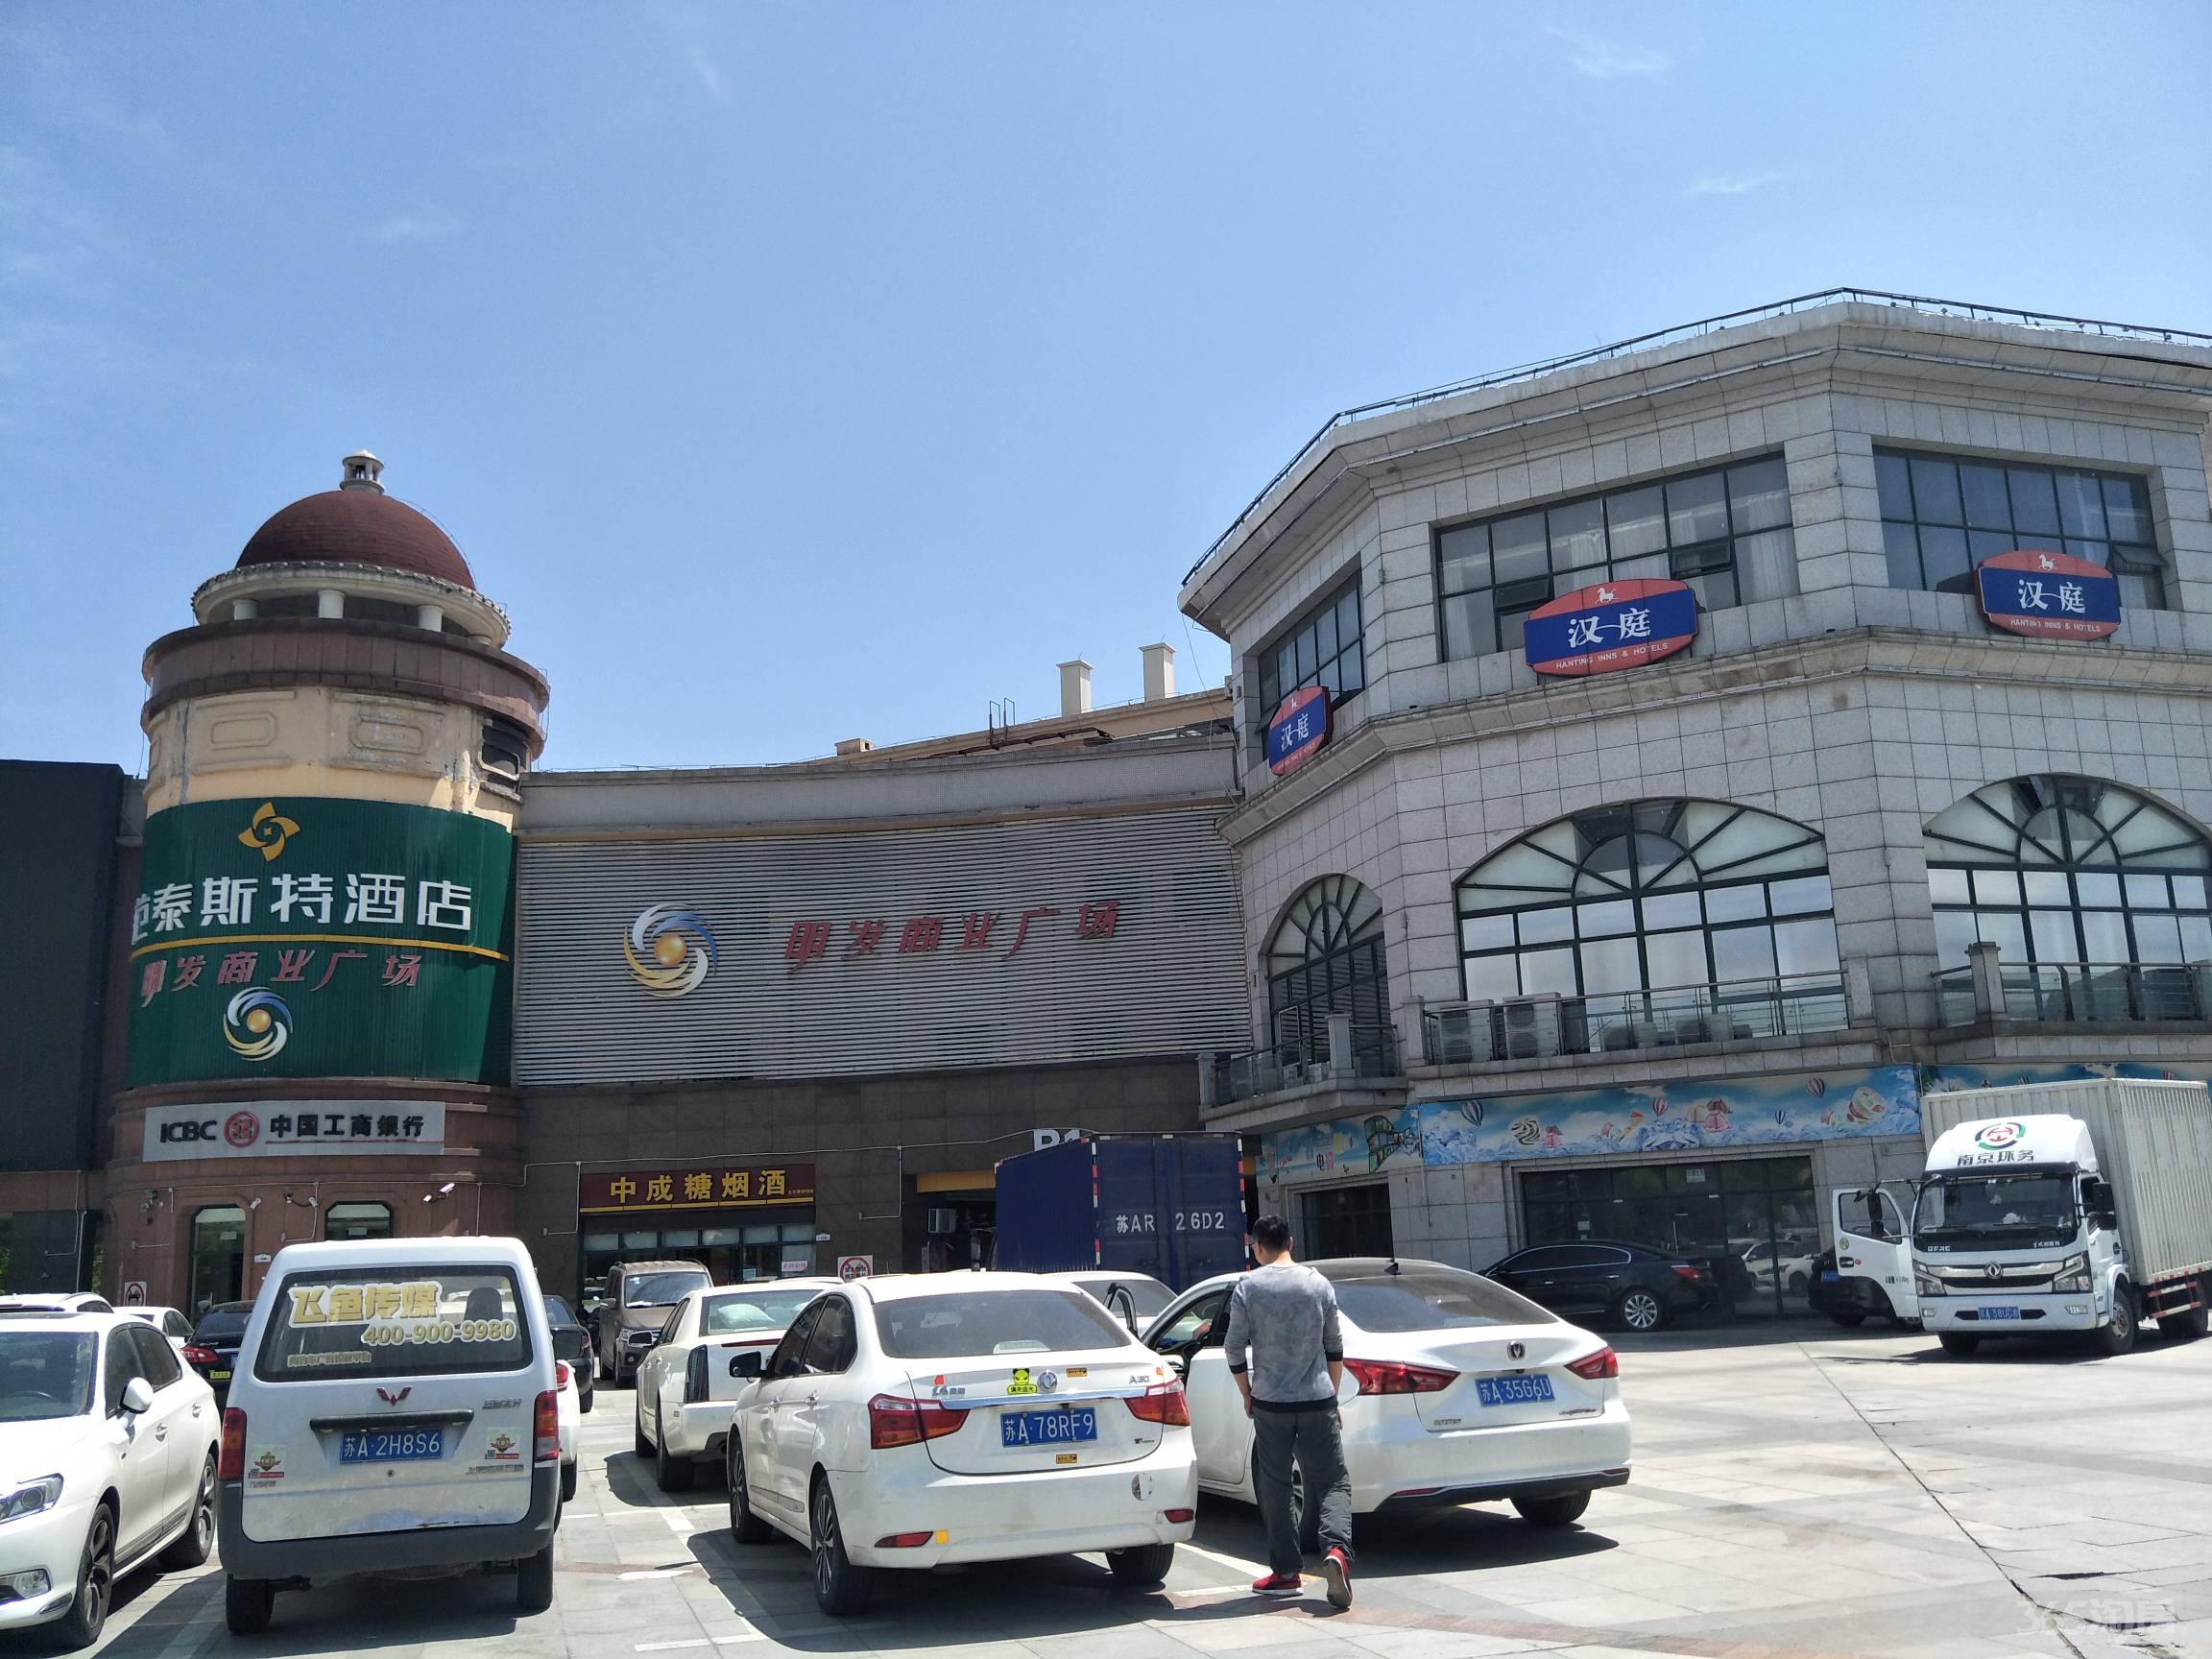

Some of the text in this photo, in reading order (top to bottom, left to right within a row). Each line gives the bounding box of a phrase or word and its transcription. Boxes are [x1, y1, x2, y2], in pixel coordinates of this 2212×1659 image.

[2018, 579, 2086, 613] 汉庭
[1568, 607, 1651, 648] 汉庭
[2010, 618, 2041, 629] HANTING
[2074, 623, 2101, 633] HOTELS
[1555, 657, 1594, 669] HANTING
[1598, 651, 1618, 662] INNS
[1633, 642, 1669, 655] HOTELS
[1281, 713, 1310, 753] 汉庭
[783, 901, 1121, 975] 明发商业广场
[160, 1114, 424, 1143] ICBC 中国工商银行
[610, 1168, 786, 1204] 中成糖烟酒
[1116, 1212, 1225, 1234] 苏AR 26D2
[290, 1283, 439, 1324] 飞鱼传媒
[362, 1319, 516, 1346] 400-900-9980
[342, 1432, 442, 1459] 苏A·2H8S6
